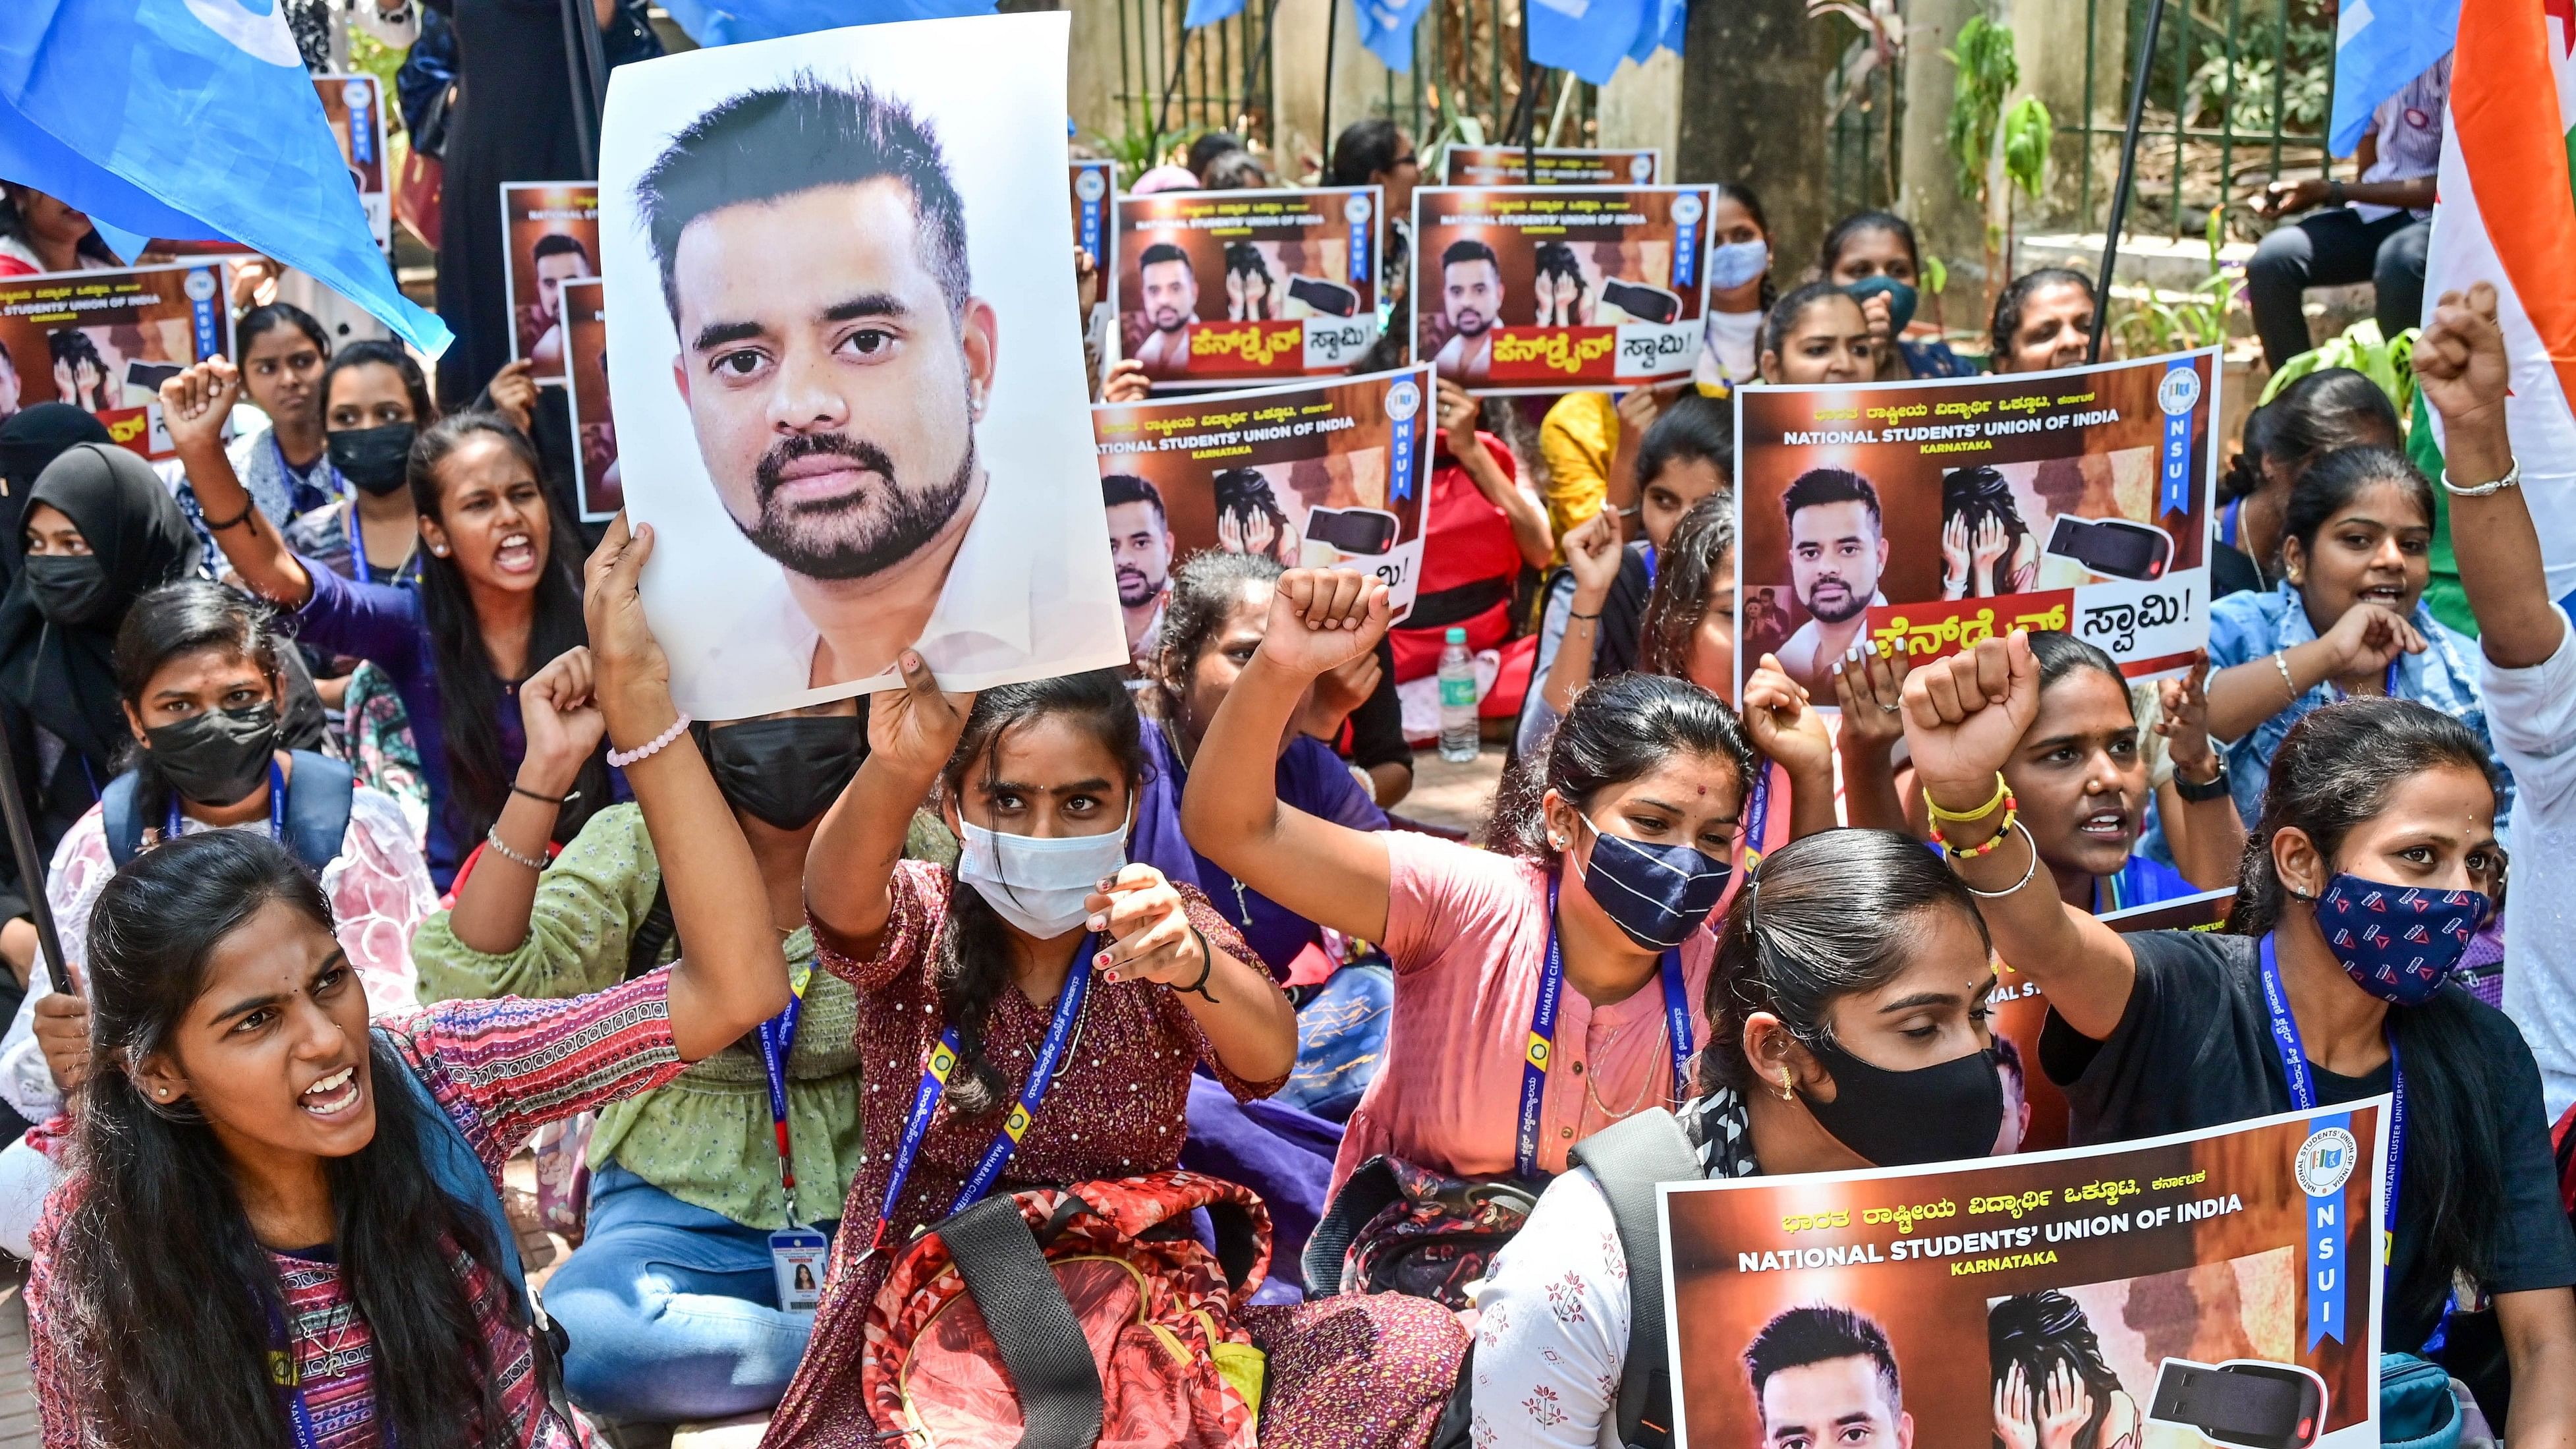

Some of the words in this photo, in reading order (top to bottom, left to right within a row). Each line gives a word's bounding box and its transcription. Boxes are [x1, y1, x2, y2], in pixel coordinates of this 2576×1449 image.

[1559, 214, 1597, 225] UNION
[1597, 214, 1613, 225] OF
[1615, 213, 1647, 225] INDIA
[1679, 227, 1692, 278] NSUI
[1243, 425, 1291, 442] UNION
[1293, 422, 1314, 436] OF
[1316, 416, 1355, 434] INDIA
[1783, 430, 1878, 445] NATIONAL
[1984, 418, 2042, 436] UNION
[2045, 414, 2069, 430] OF
[2073, 409, 2119, 427] INDIA
[1191, 444, 1252, 459] KARNATAKA
[1395, 424, 1409, 490] NSUI
[1920, 440, 1993, 455] KARNATAKA
[2168, 420, 2185, 500] NSUI
[1540, 977, 1555, 1025] MAHARANI
[763, 1041, 775, 1072] CLUSTER
[2340, 1133, 2354, 1153] UNION
[2390, 1125, 2401, 1162] CLUSTER
[974, 1144, 1004, 1185] MAHARANI
[2298, 1160, 2316, 1193] NATIONAL
[2333, 1168, 2349, 1187] INDIA
[2346, 1155, 2354, 1166] OF
[1781, 1208, 1850, 1234] ಭಾರತ
[1862, 1198, 1956, 1234] ರಾಷ್ಟ್ರೀಯ
[1968, 1190, 2053, 1219] ವಿದ್ಯಾರ್ಥಿ
[2151, 1169, 2206, 1191] ಕರ್ನಾಟಕ
[1739, 1244, 1884, 1272] NATIONAL
[2046, 1215, 2129, 1242] UNION
[2136, 1207, 2171, 1230] OF
[2177, 1193, 2243, 1223] INDIA
[1951, 1250, 2058, 1276] KARNATAKA
[2317, 1204, 2336, 1323] NSUI
